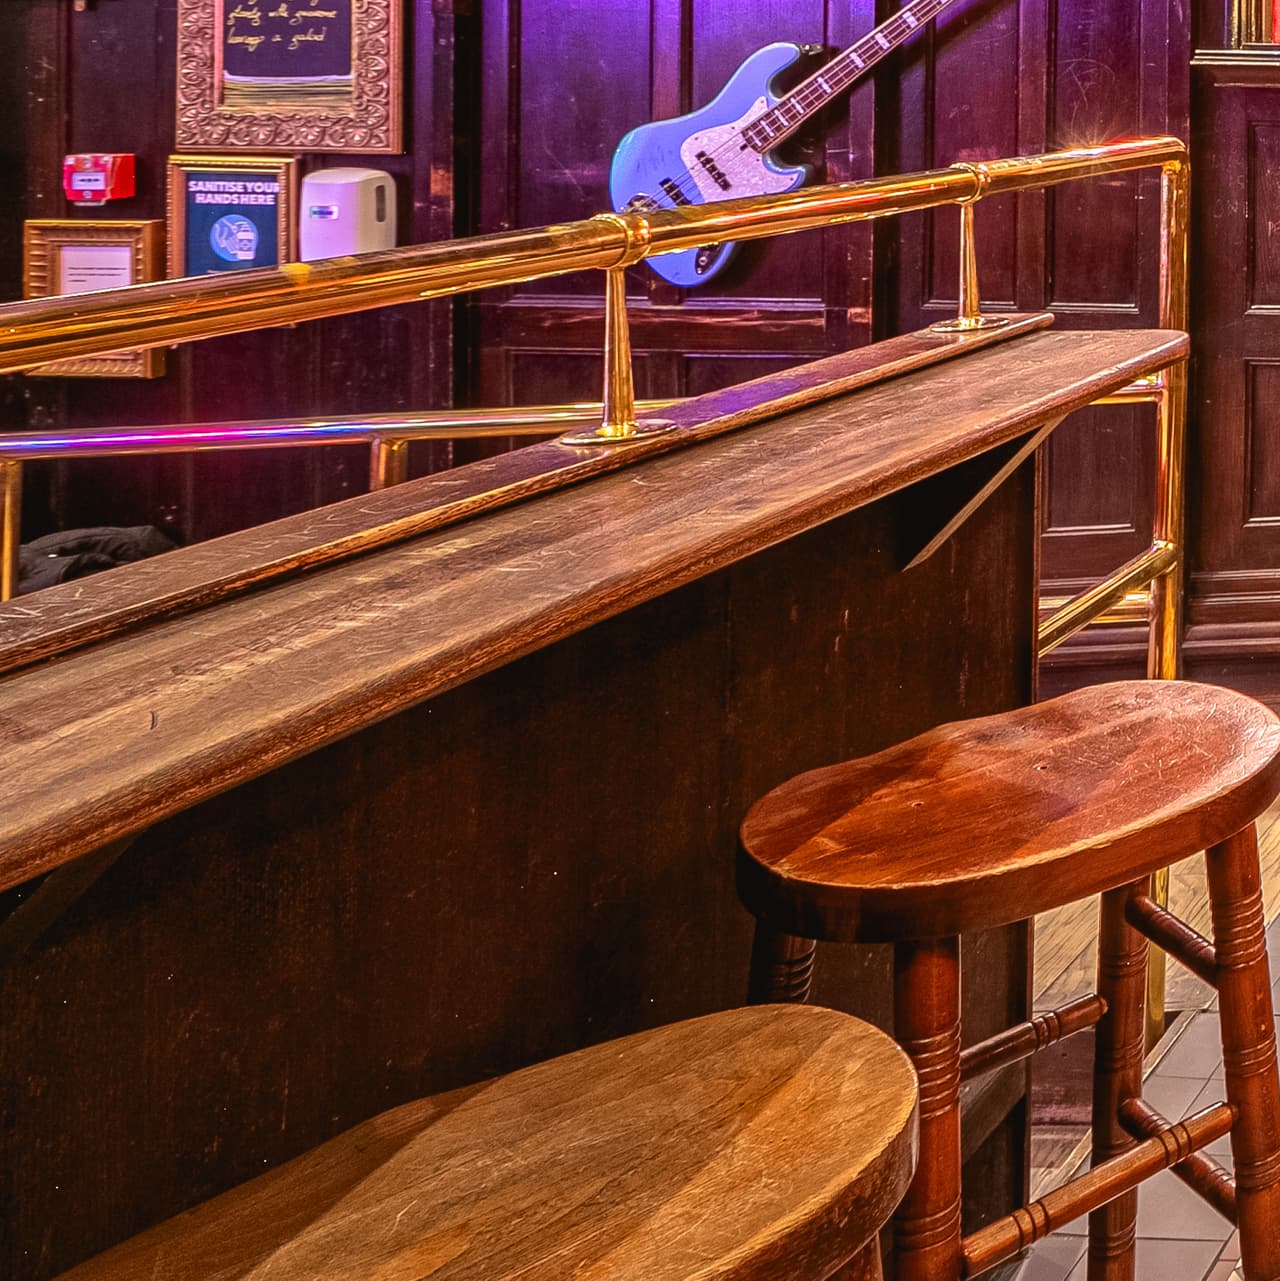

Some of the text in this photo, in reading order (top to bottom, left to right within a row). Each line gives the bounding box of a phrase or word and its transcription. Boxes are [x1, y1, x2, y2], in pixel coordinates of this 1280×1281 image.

[188, 180, 246, 193] SANITISE
[195, 192, 276, 205] HANDS HERE
